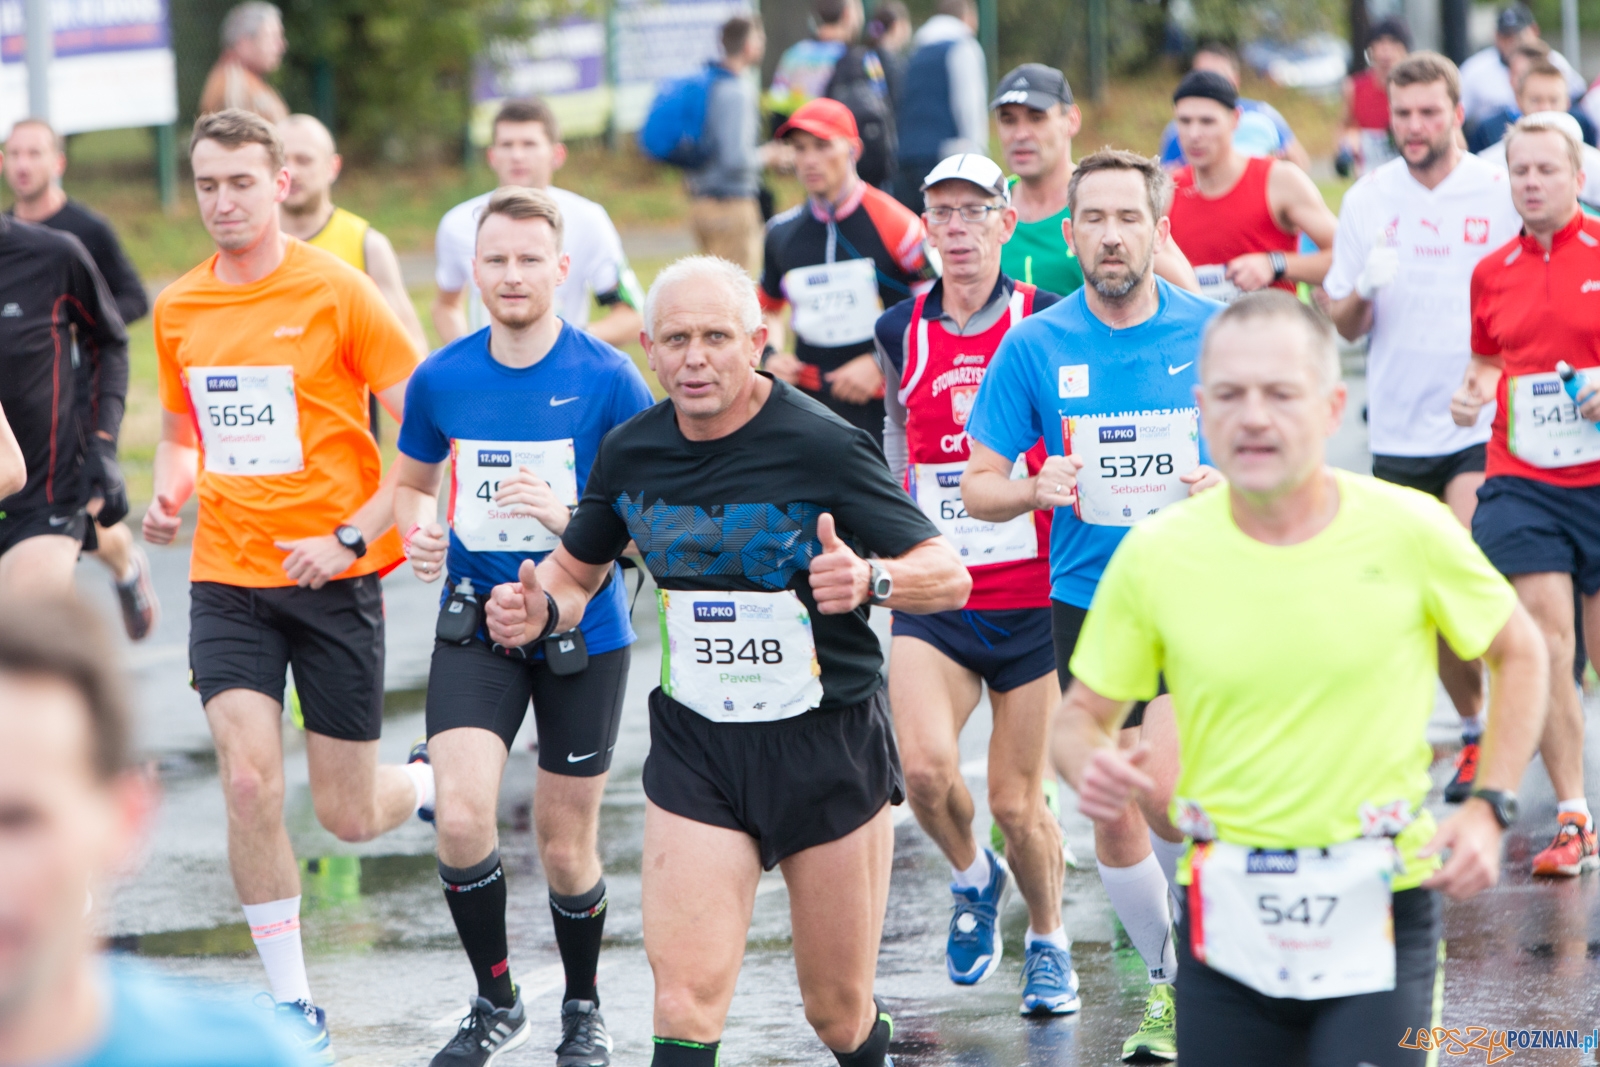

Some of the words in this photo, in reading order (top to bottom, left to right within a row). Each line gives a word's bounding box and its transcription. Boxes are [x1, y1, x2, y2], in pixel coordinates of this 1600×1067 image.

[1533, 402, 1589, 428] 543
[1101, 429, 1134, 440] 17.PKO
[479, 452, 511, 464] 17.PKO
[1099, 453, 1174, 478] 5378
[1110, 483, 1167, 495] Sebastian
[696, 606, 734, 618] 17.PKO
[694, 637, 783, 665] 3348
[719, 672, 761, 684] Paweł
[1257, 894, 1340, 928] 547
